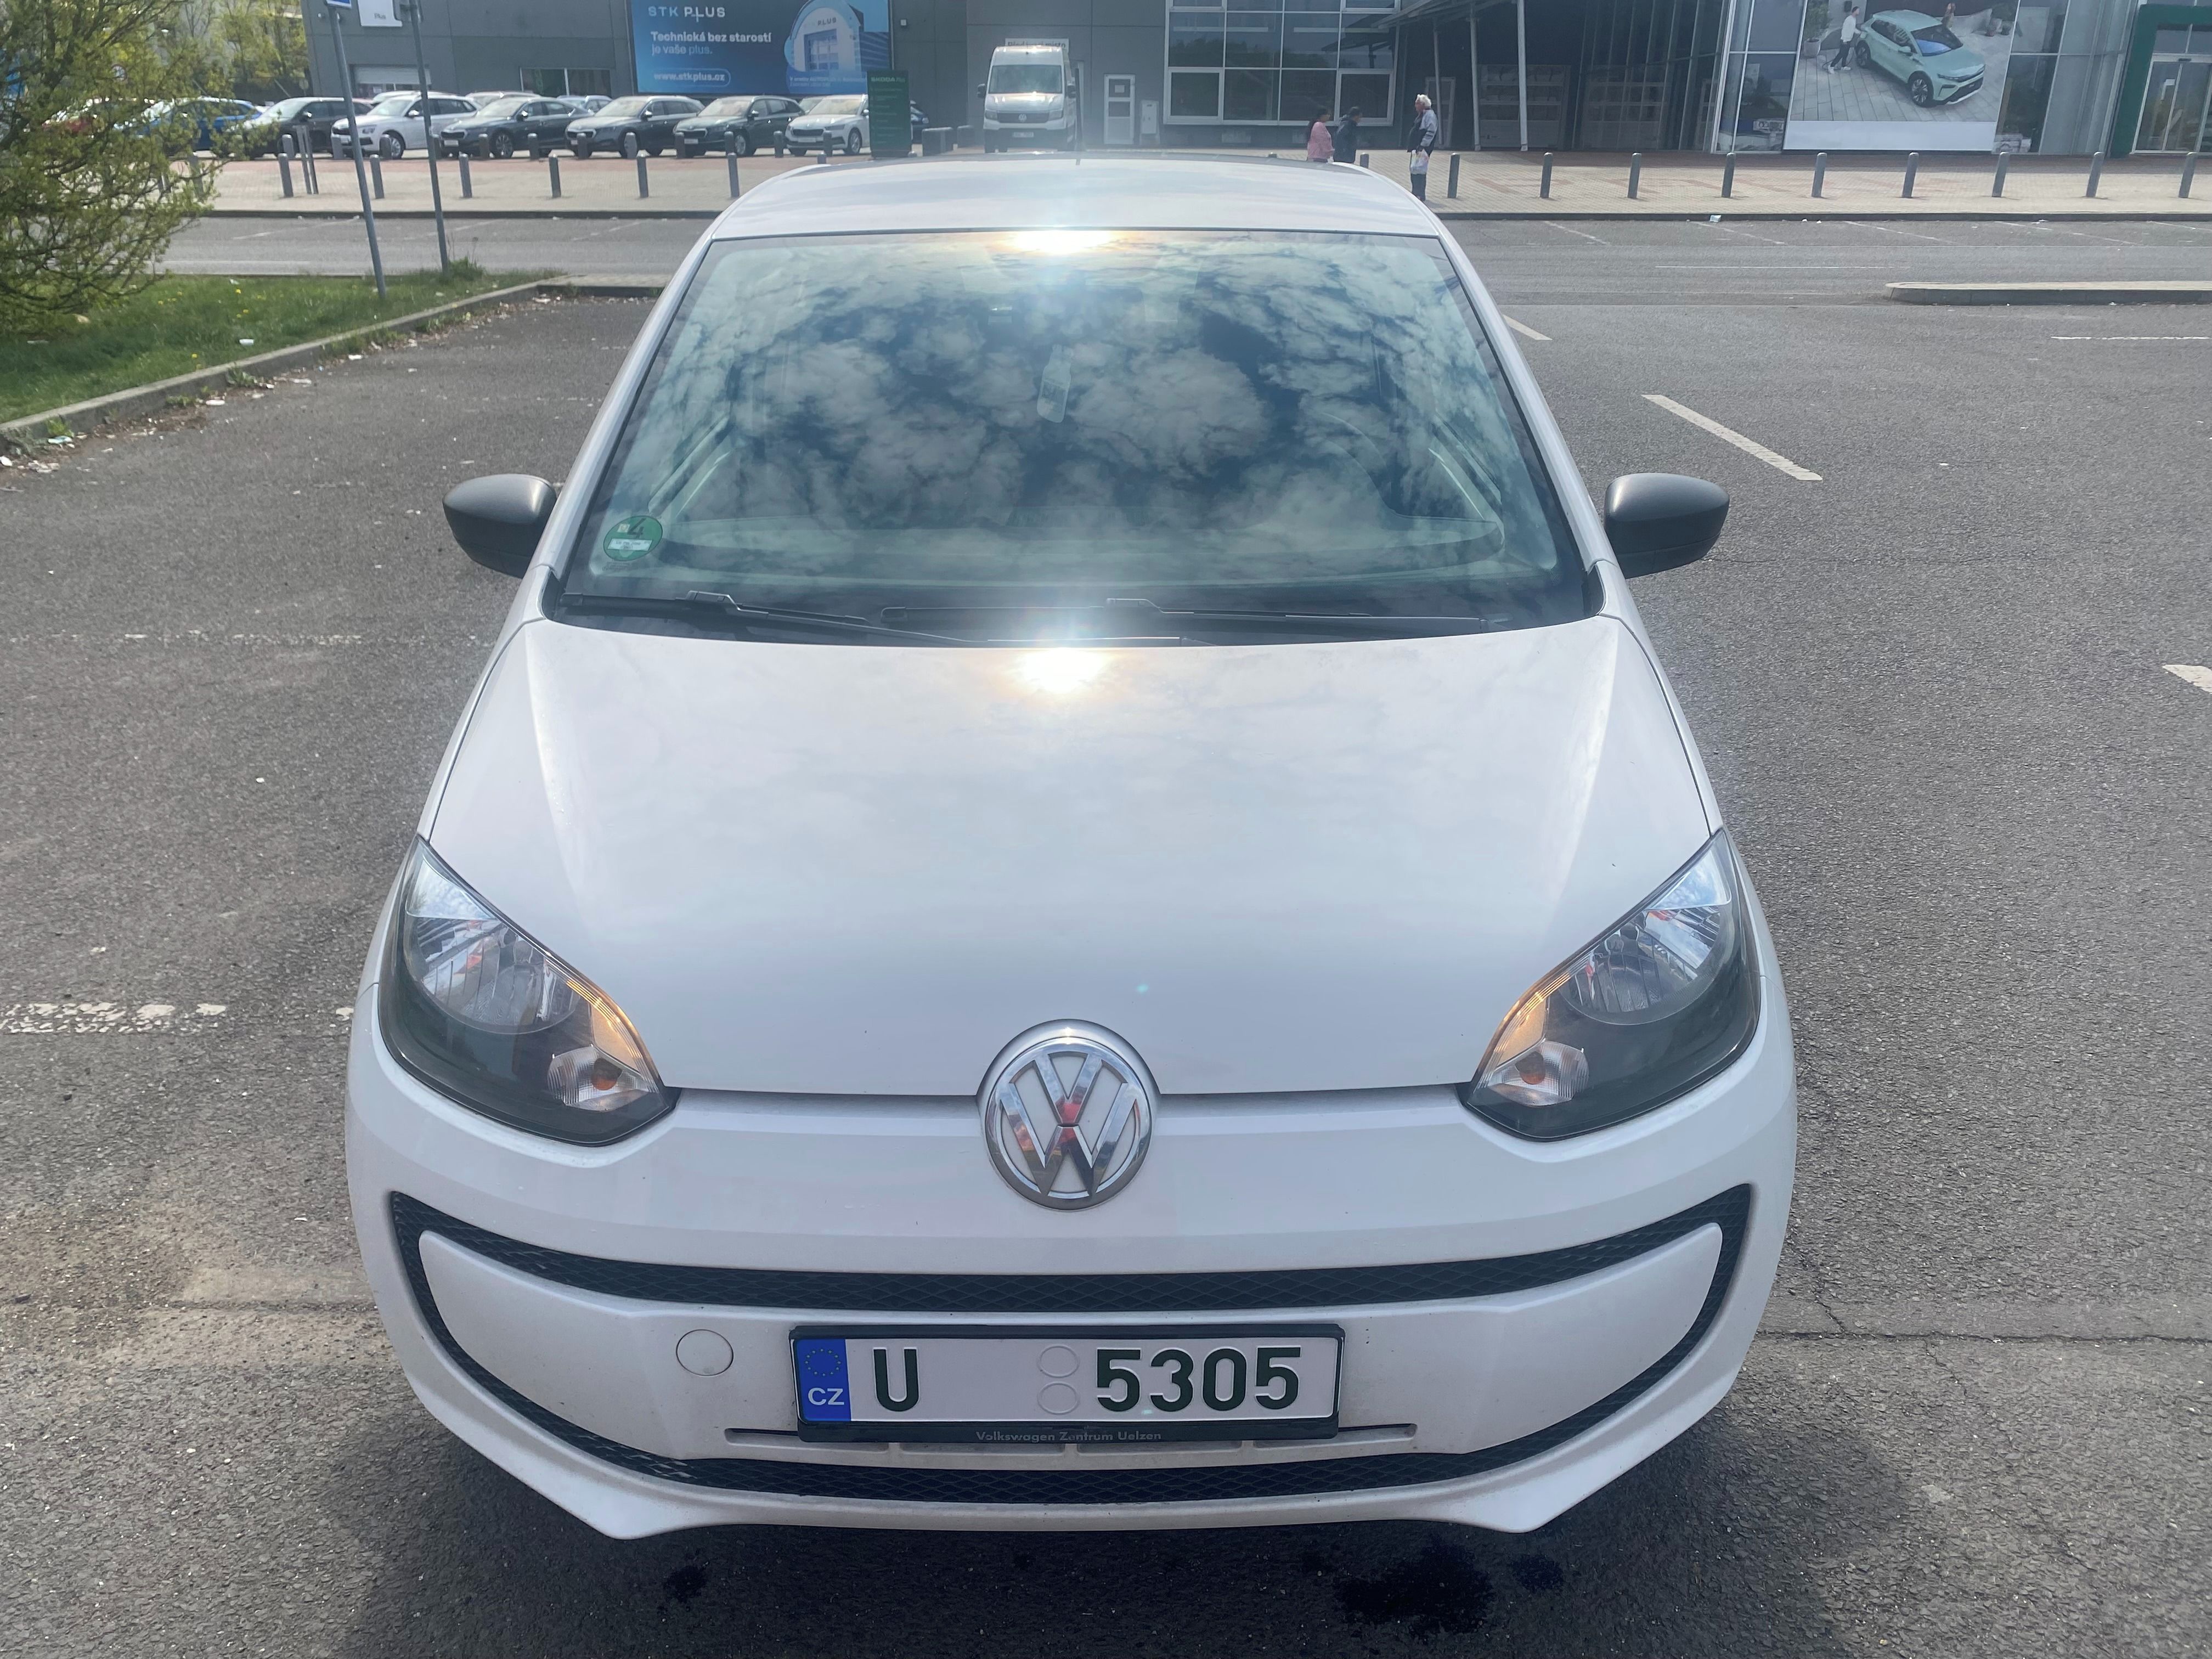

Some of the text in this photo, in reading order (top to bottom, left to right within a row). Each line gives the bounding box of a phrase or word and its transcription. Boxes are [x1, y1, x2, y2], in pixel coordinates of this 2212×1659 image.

[648, 6, 725, 22] STK PLUS
[651, 31, 772, 43] Technická bez starostí
[652, 44, 713, 55] je vaše plus.
[654, 72, 725, 82] www.stkplus.cz
[873, 1346, 1301, 1412] U 5305
[808, 1387, 845, 1406] CZ
[976, 1431, 1162, 1443] Volkswagen Zentrum Uelzen
